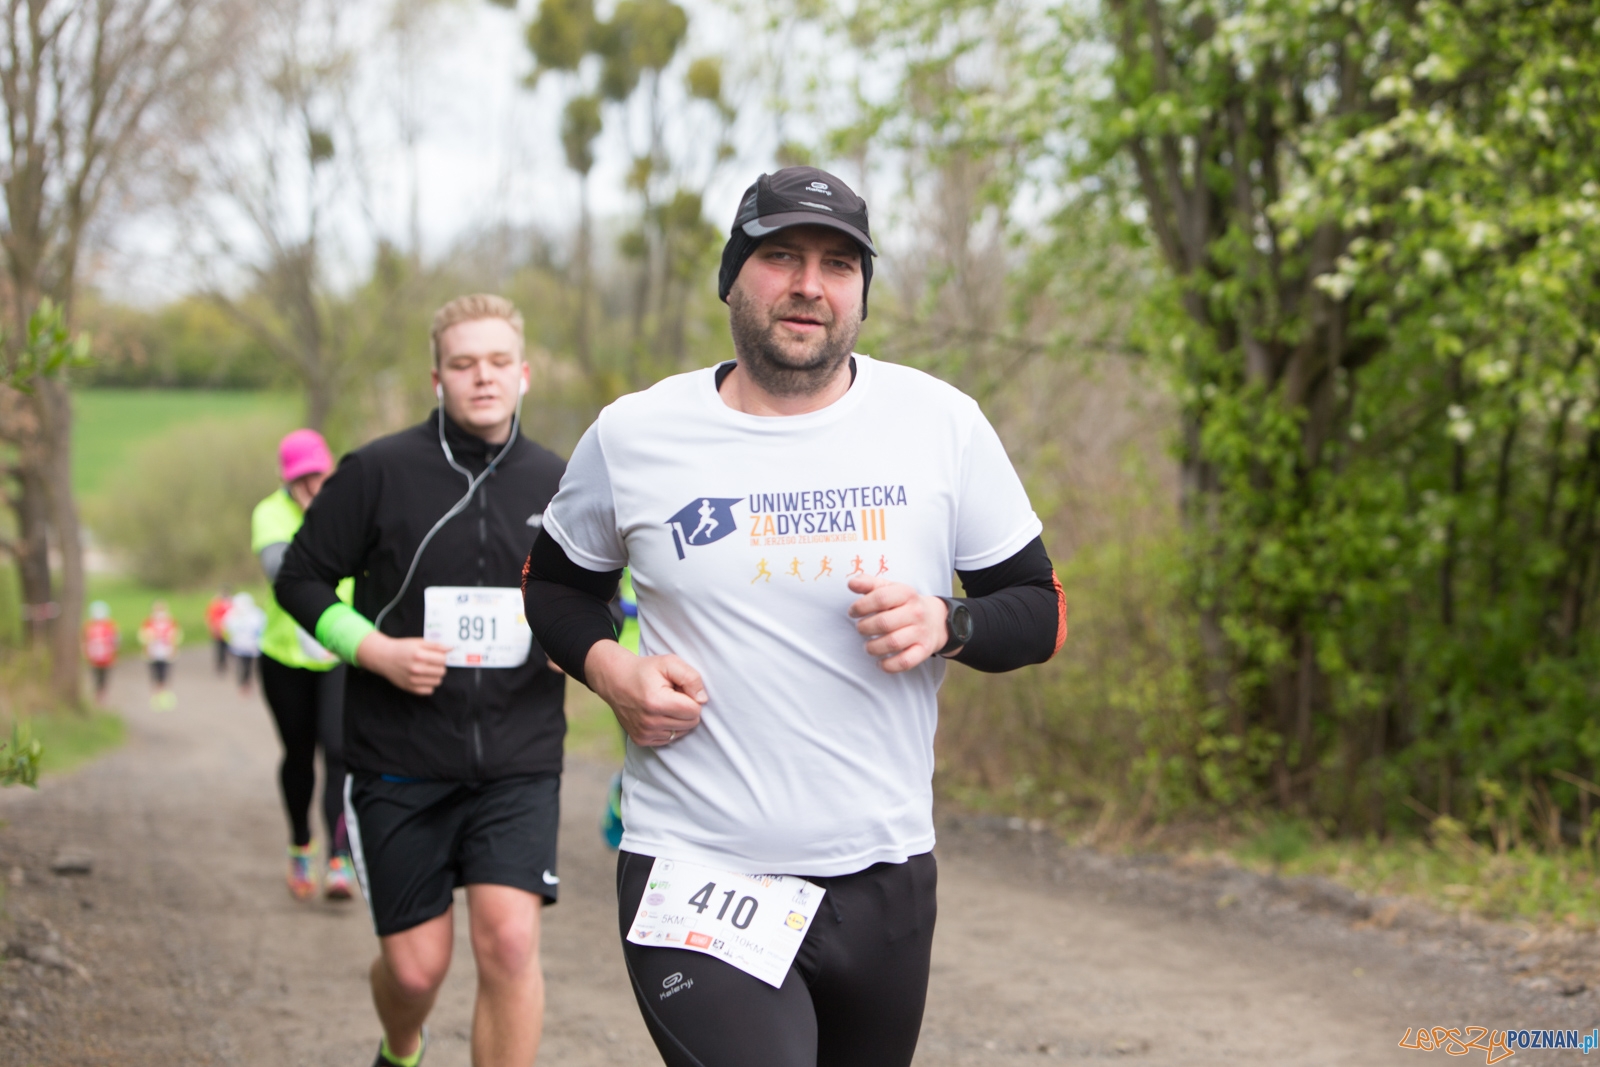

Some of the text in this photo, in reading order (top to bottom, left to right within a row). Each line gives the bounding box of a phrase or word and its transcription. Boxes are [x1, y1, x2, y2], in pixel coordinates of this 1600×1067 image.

[749, 485, 908, 514] UNIWERSYTECKA
[749, 508, 887, 542] ZADYSZKA III
[763, 535, 797, 547] JERZEGO
[458, 615, 497, 641] 891
[661, 913, 685, 925] 5KM
[688, 881, 759, 930] 410
